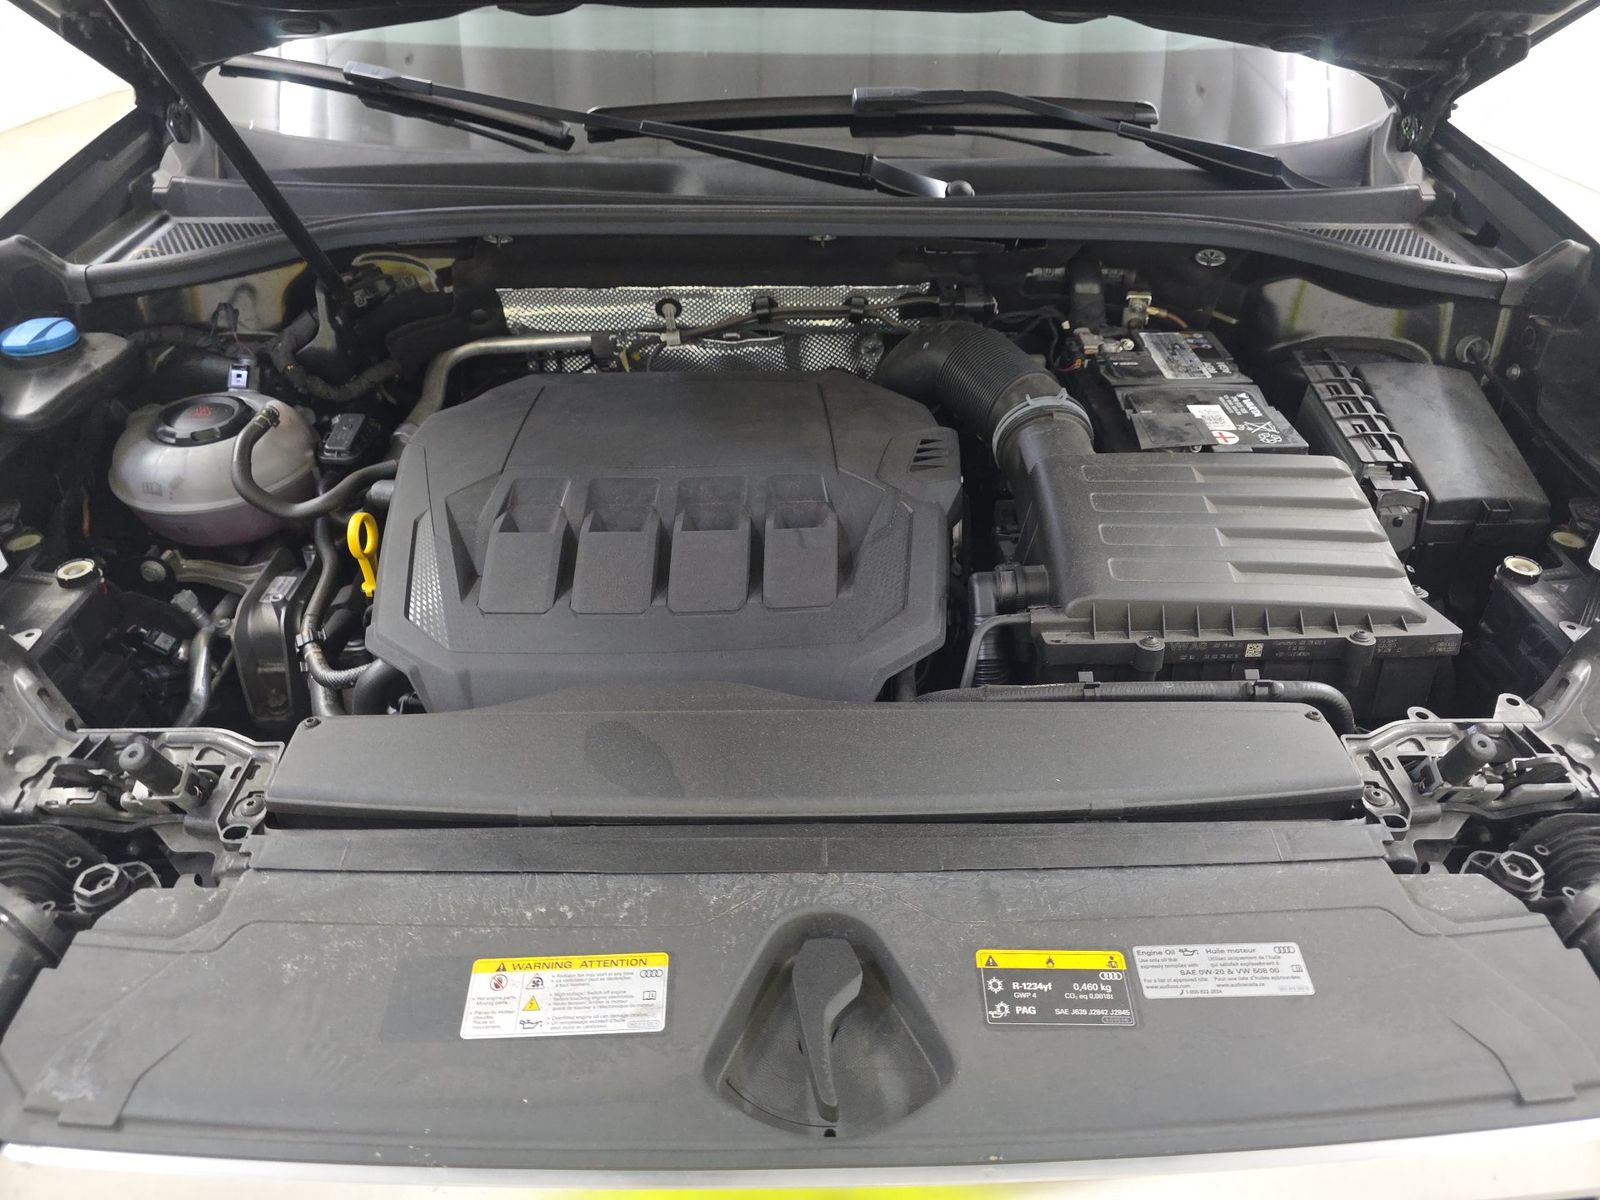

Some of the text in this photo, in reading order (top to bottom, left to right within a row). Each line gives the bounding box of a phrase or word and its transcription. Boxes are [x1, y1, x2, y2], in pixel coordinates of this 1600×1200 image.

[512, 958, 648, 971] WARNING ATTENTION
[1012, 982, 1052, 992] R-1234yf
[1073, 983, 1112, 993] 0,460 kg
[1015, 1006, 1036, 1014] PAG
